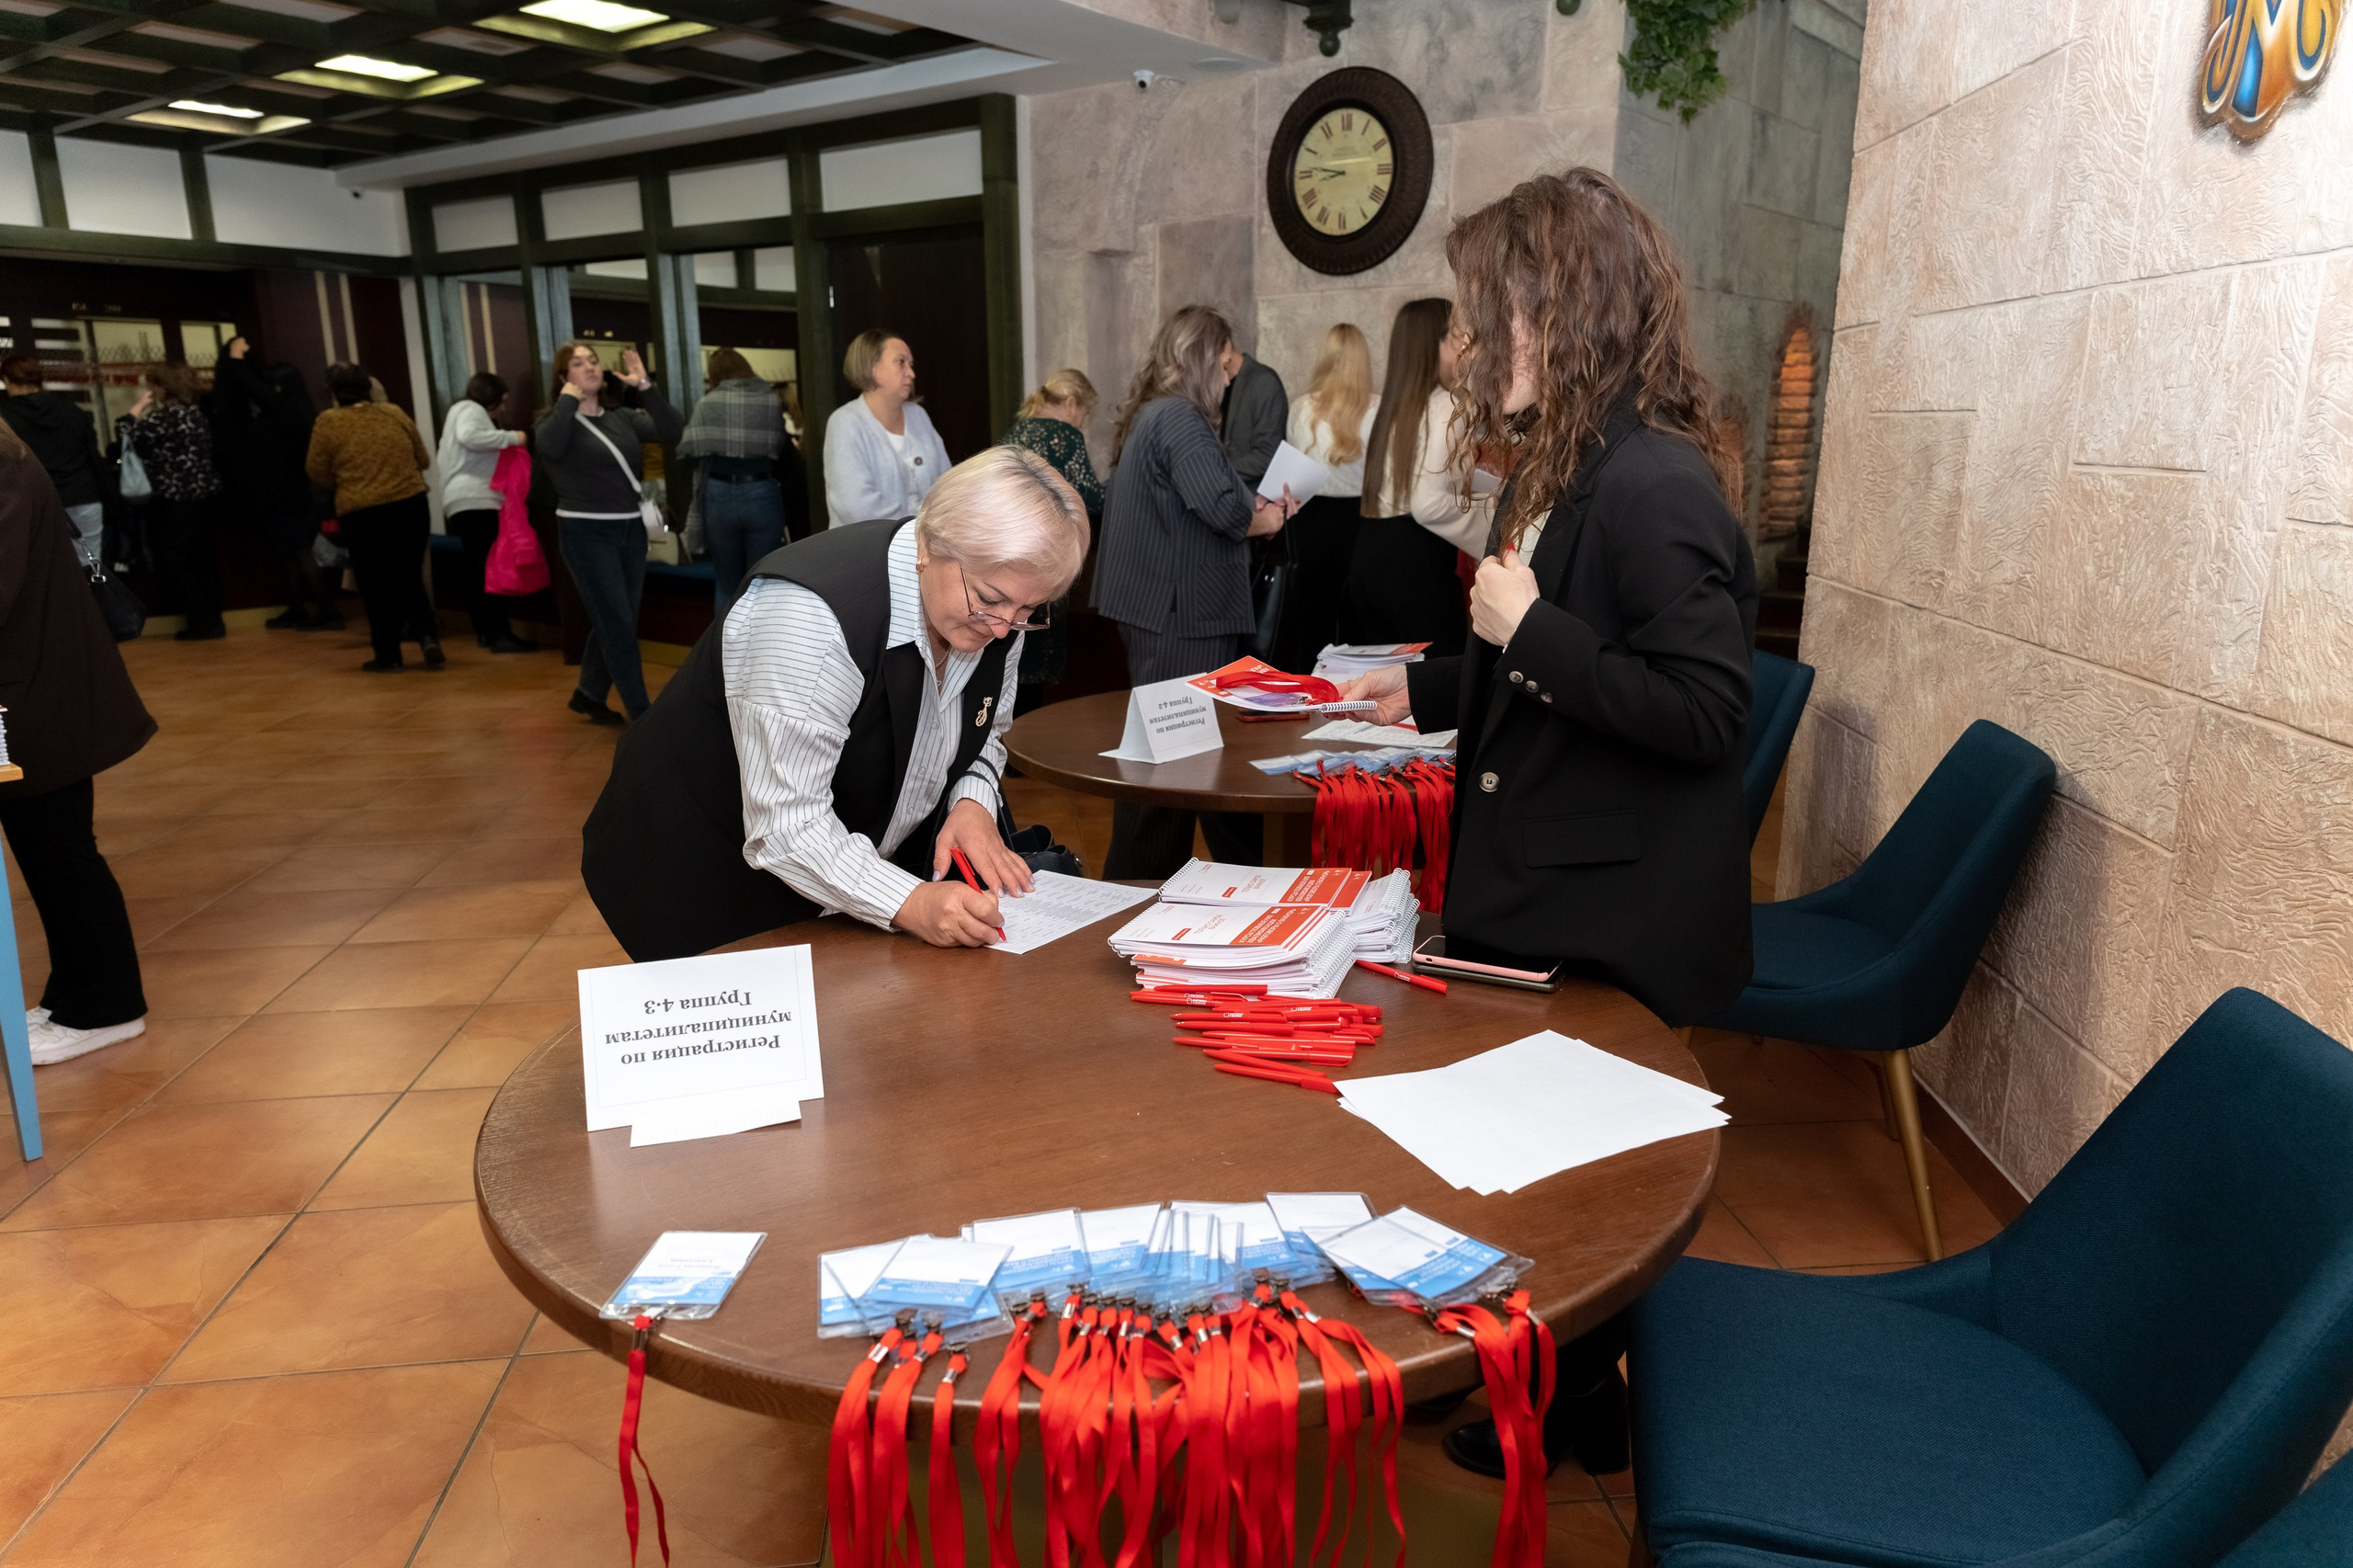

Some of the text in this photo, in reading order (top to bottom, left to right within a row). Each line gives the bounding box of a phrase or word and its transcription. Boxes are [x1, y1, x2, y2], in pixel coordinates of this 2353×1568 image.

[1169, 696, 1193, 707] Группа
[1149, 706, 1207, 724] муниципалитетам
[1165, 718, 1206, 733] Регистрация
[643, 990, 752, 1015] Группа 4.3
[605, 1010, 792, 1045] муниципалитетам
[620, 1035, 780, 1064] Регистрация по
